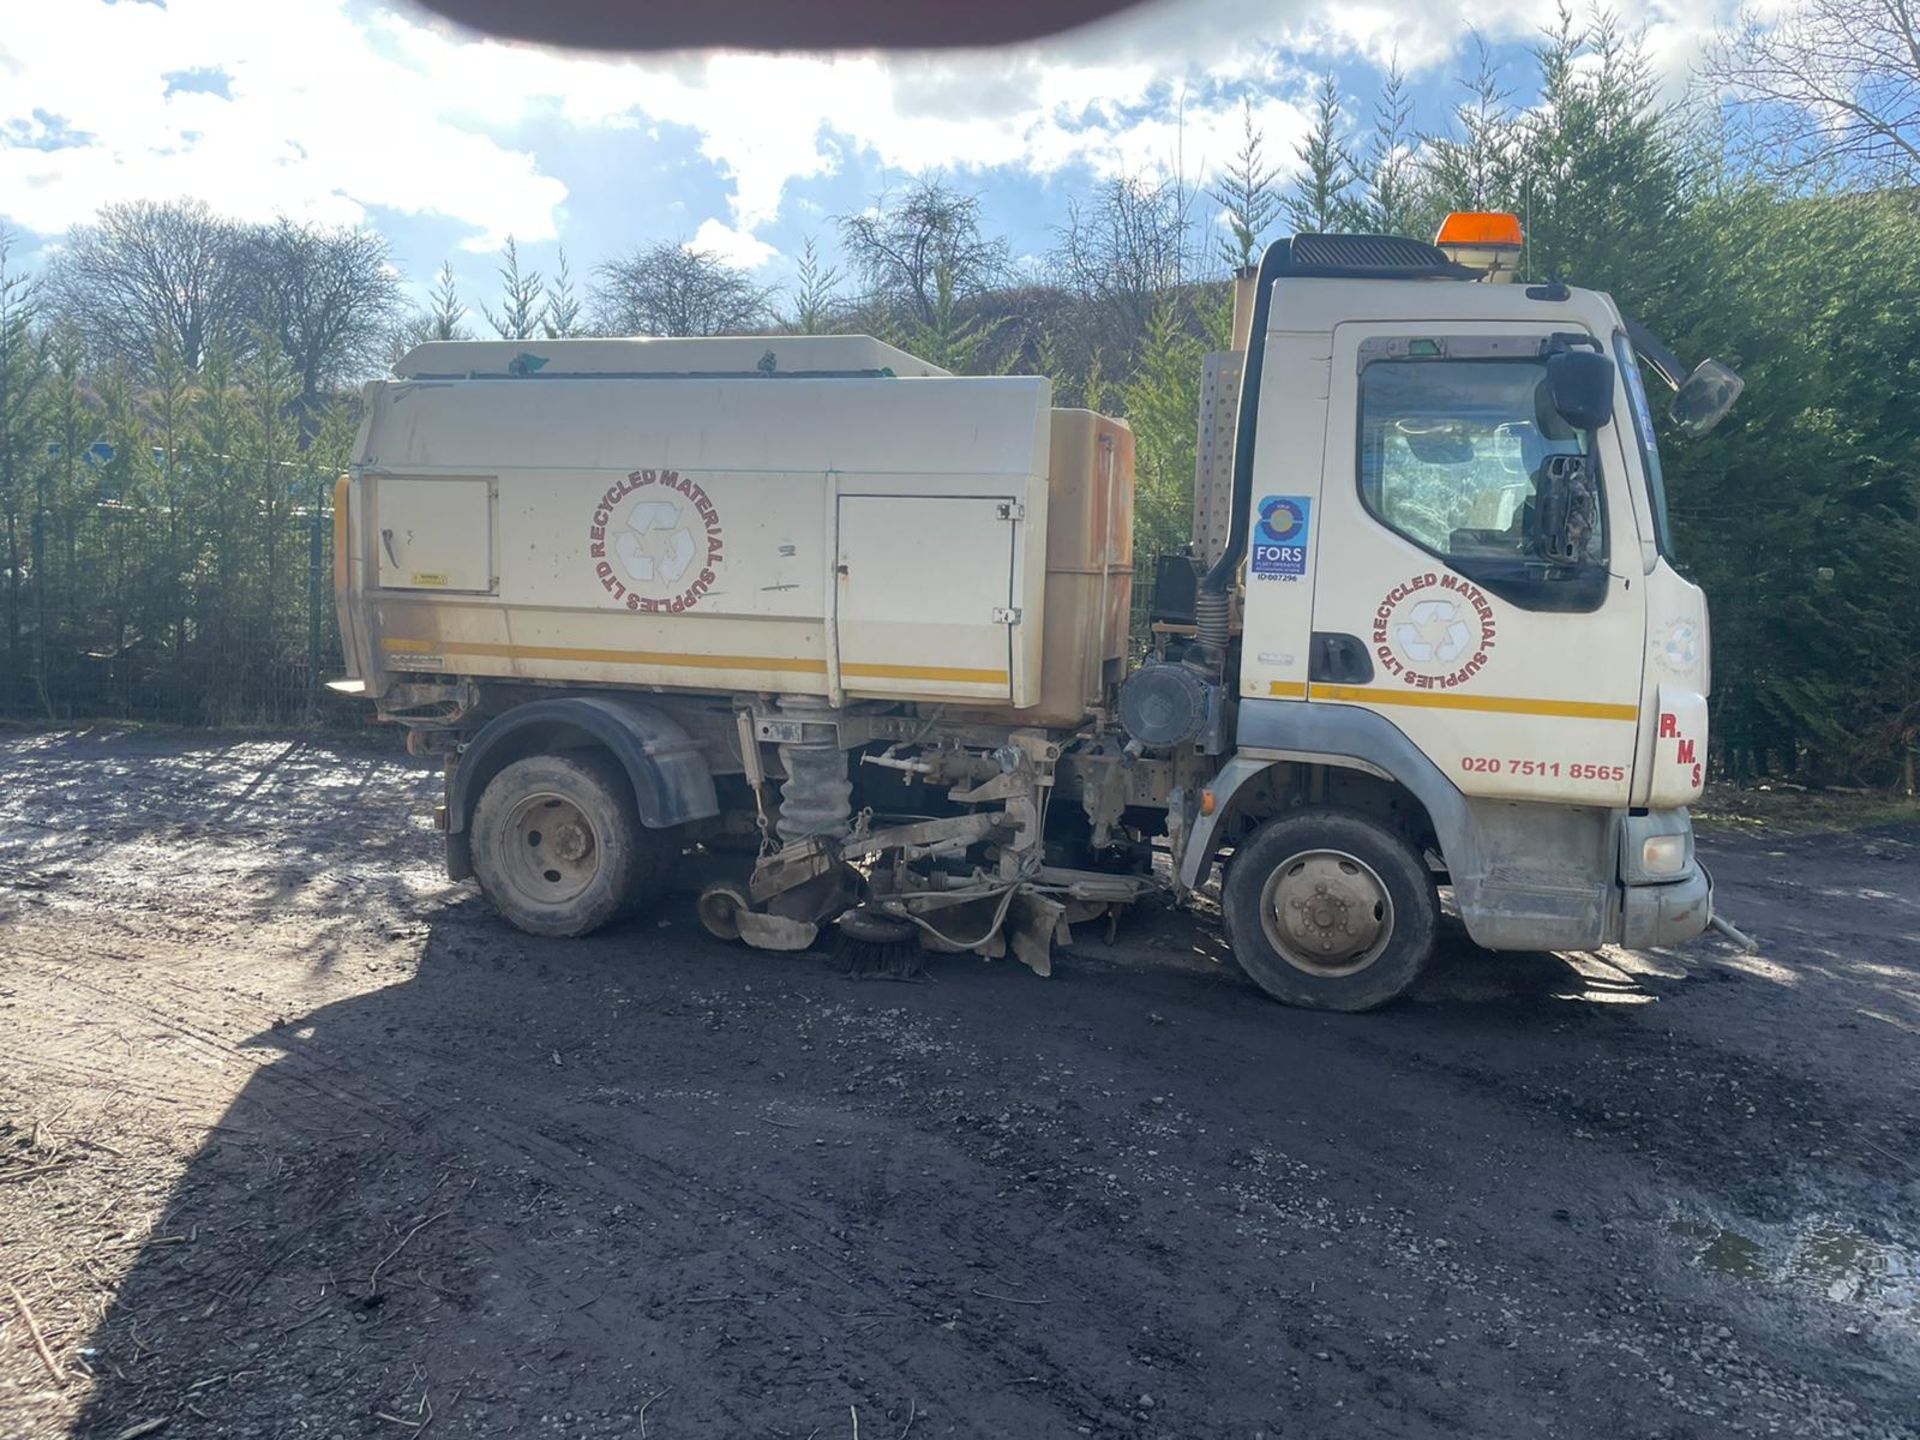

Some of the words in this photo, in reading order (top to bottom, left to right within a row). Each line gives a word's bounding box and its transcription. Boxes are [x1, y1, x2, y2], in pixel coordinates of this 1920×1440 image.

[590, 469, 656, 558] RECYCLED
[659, 469, 723, 567] MATERIAL
[1257, 547, 1302, 562] FORS
[595, 561, 626, 600] LTD
[626, 568, 716, 613] SUPPLIES
[1373, 573, 1437, 643] RECYCLED
[1440, 574, 1496, 651] MATERIAL
[1377, 646, 1404, 676] LTD
[1404, 652, 1488, 689] SUPPLIES
[1660, 713, 1681, 738] R.
[1461, 757, 1501, 773] 020
[1508, 760, 1561, 777] 7511
[1569, 764, 1624, 782] 8565
[1677, 739, 1696, 764] M.
